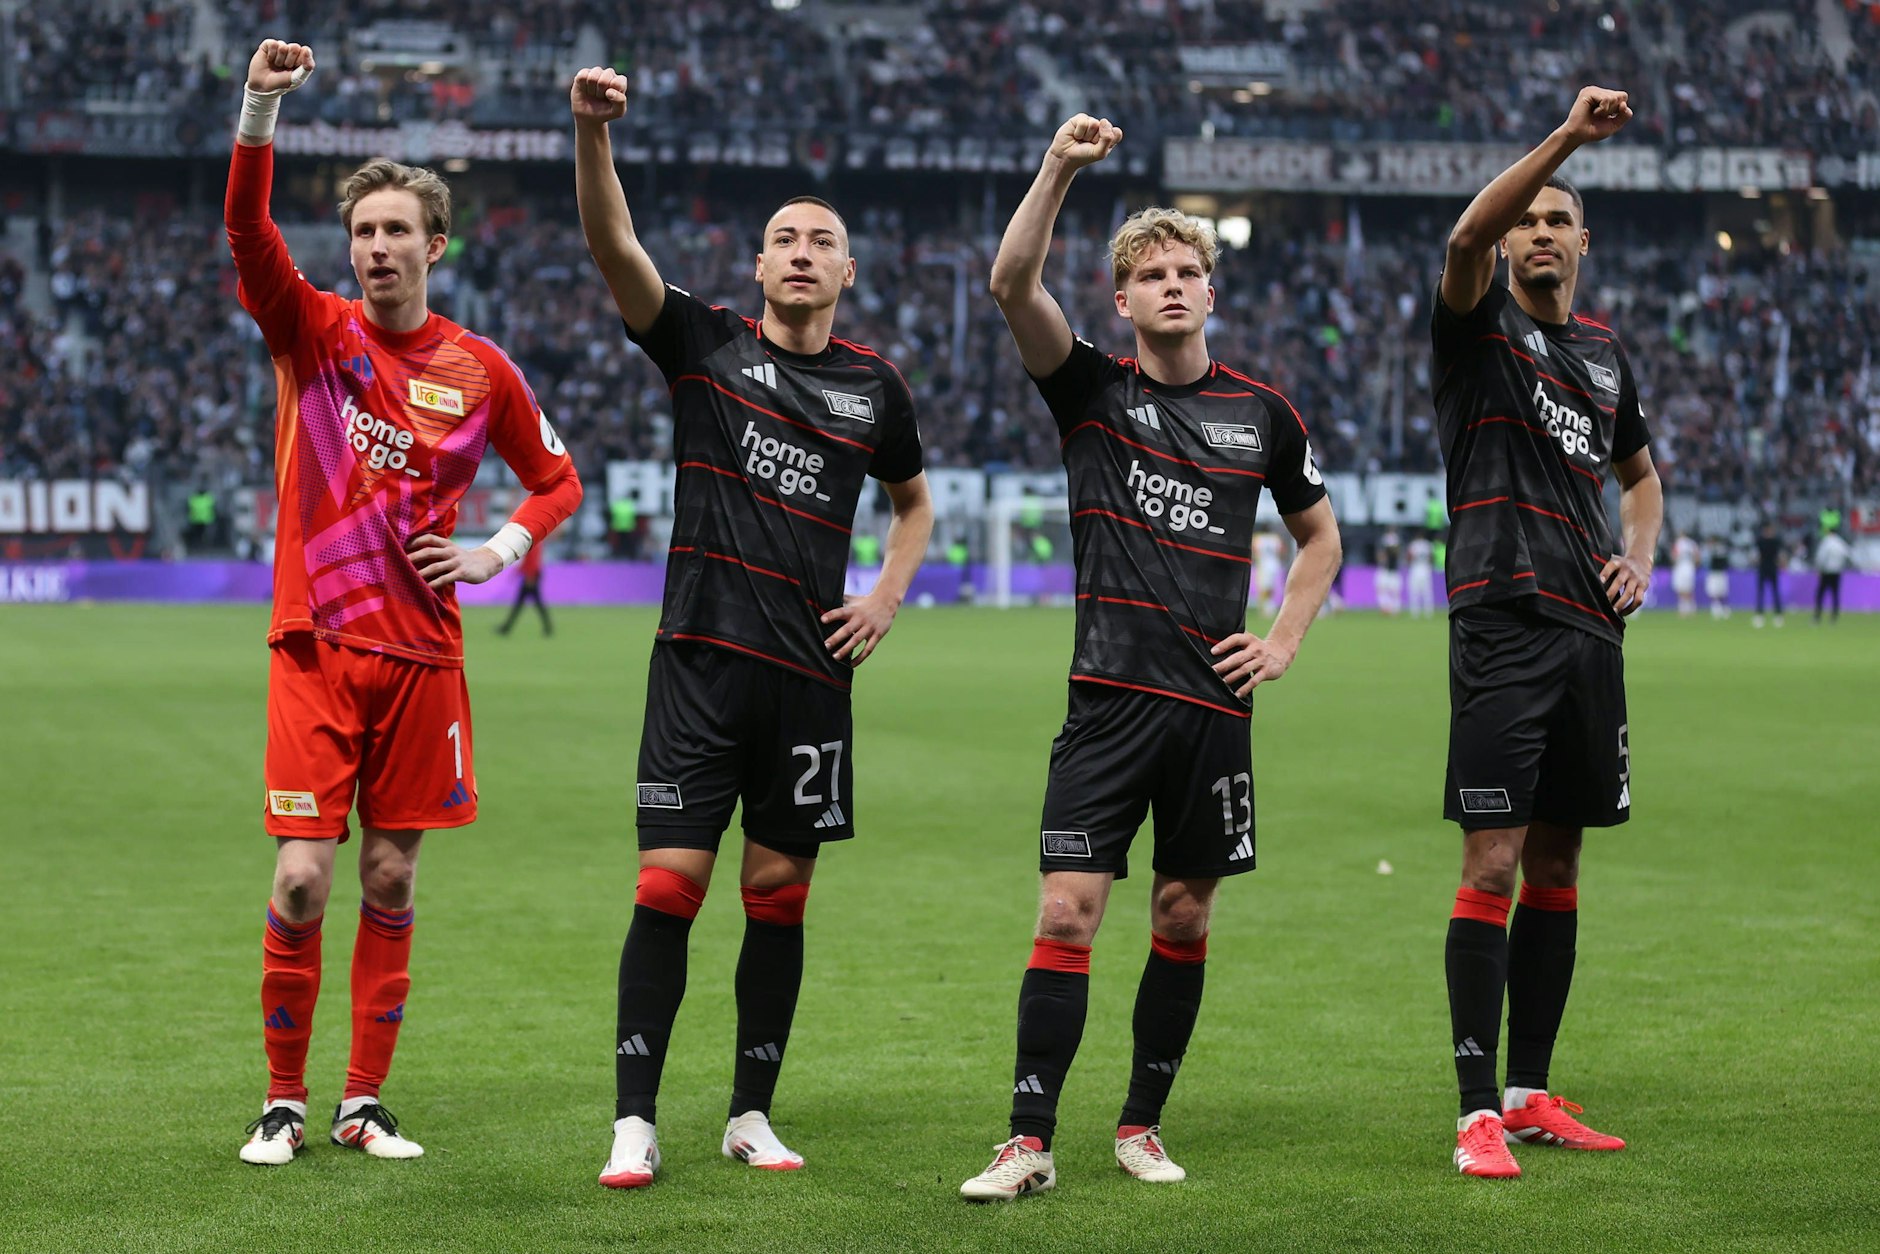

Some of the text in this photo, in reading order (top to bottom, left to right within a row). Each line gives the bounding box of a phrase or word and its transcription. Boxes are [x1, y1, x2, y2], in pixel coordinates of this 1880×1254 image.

[340, 395, 414, 450] home
[345, 422, 369, 452] to
[740, 421, 825, 474] home
[746, 450, 776, 479] to
[1127, 460, 1213, 507] home
[1135, 490, 1165, 518] to
[447, 720, 463, 779] 1
[792, 740, 843, 806] 27
[1211, 772, 1252, 836] 13
